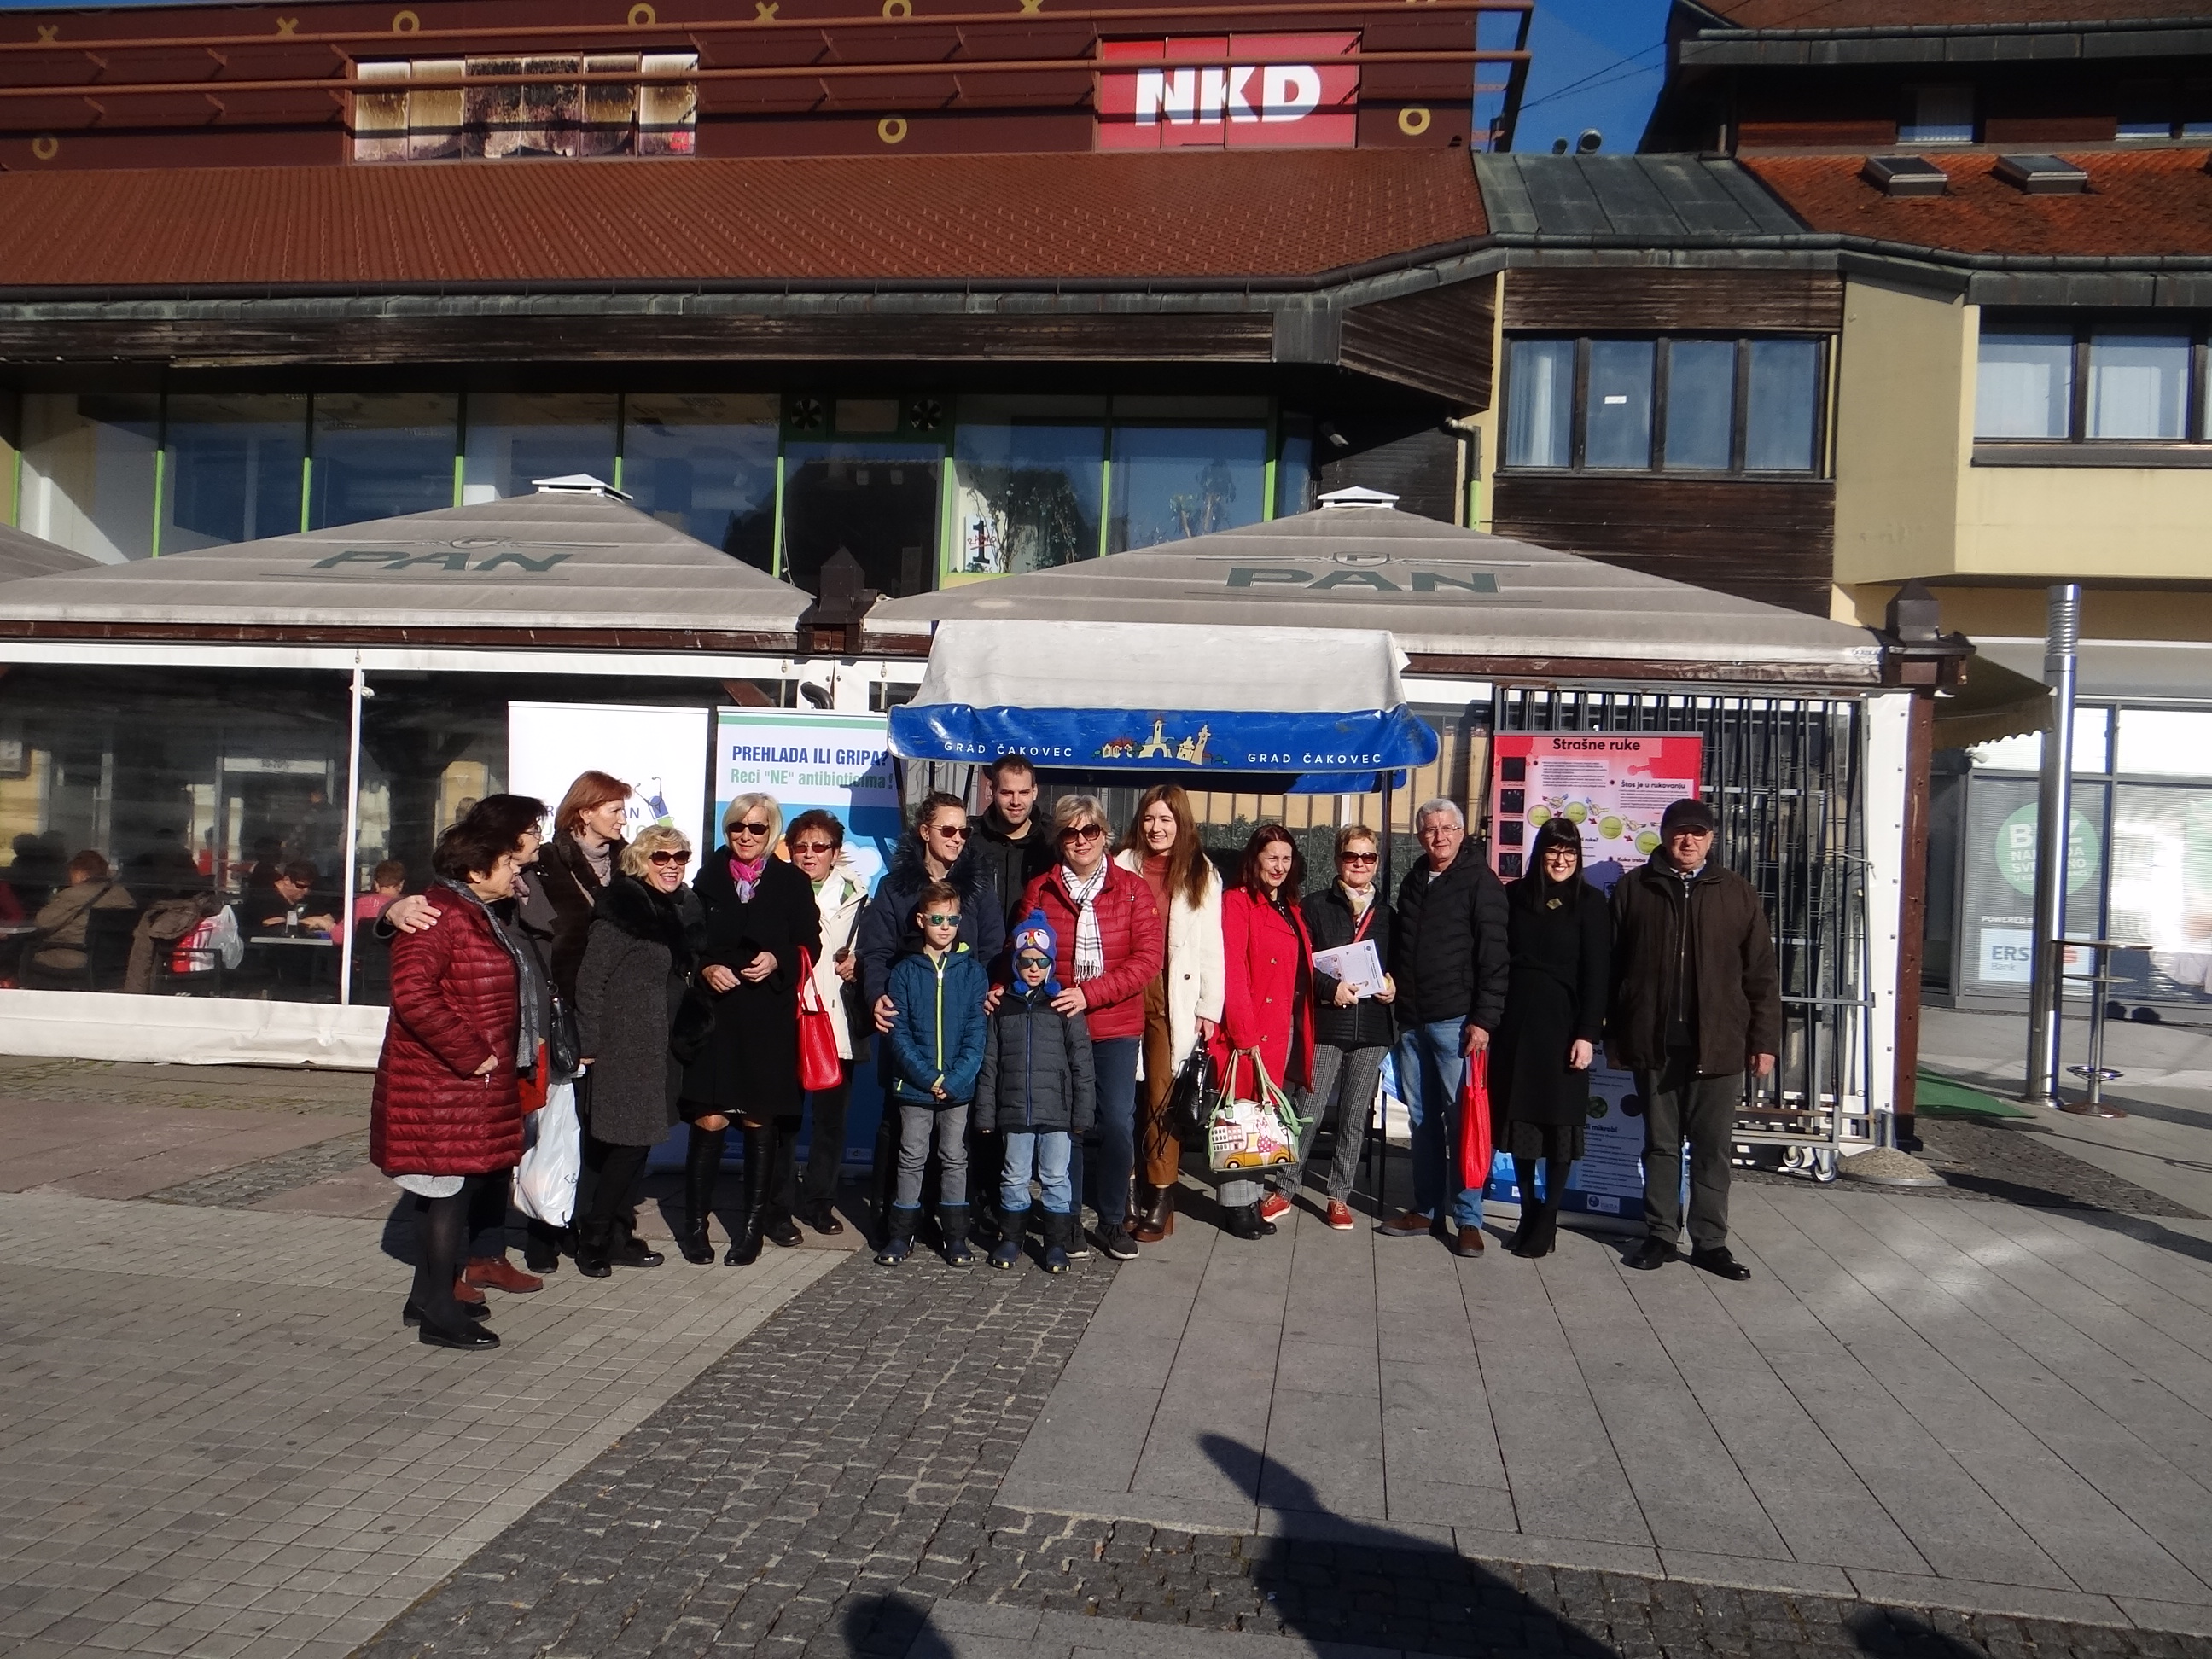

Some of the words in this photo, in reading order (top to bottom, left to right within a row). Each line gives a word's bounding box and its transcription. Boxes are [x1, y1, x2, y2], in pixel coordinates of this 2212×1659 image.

[1135, 65, 1321, 127] NKD
[310, 550, 574, 572] PAN
[1225, 567, 1501, 593] PAN
[944, 742, 986, 754] GRAD
[997, 743, 1073, 758] ČAKOVEC
[1552, 738, 1606, 751] Strašne
[1610, 739, 1641, 751] ruke
[732, 745, 808, 764] PREHLADA
[813, 748, 831, 765] ILI
[835, 749, 889, 766] GRIPA?
[1247, 753, 1291, 763] GRAD
[1302, 753, 1382, 765] ČAKOVEC
[731, 768, 760, 784] Reci
[765, 770, 795, 785] "NE"
